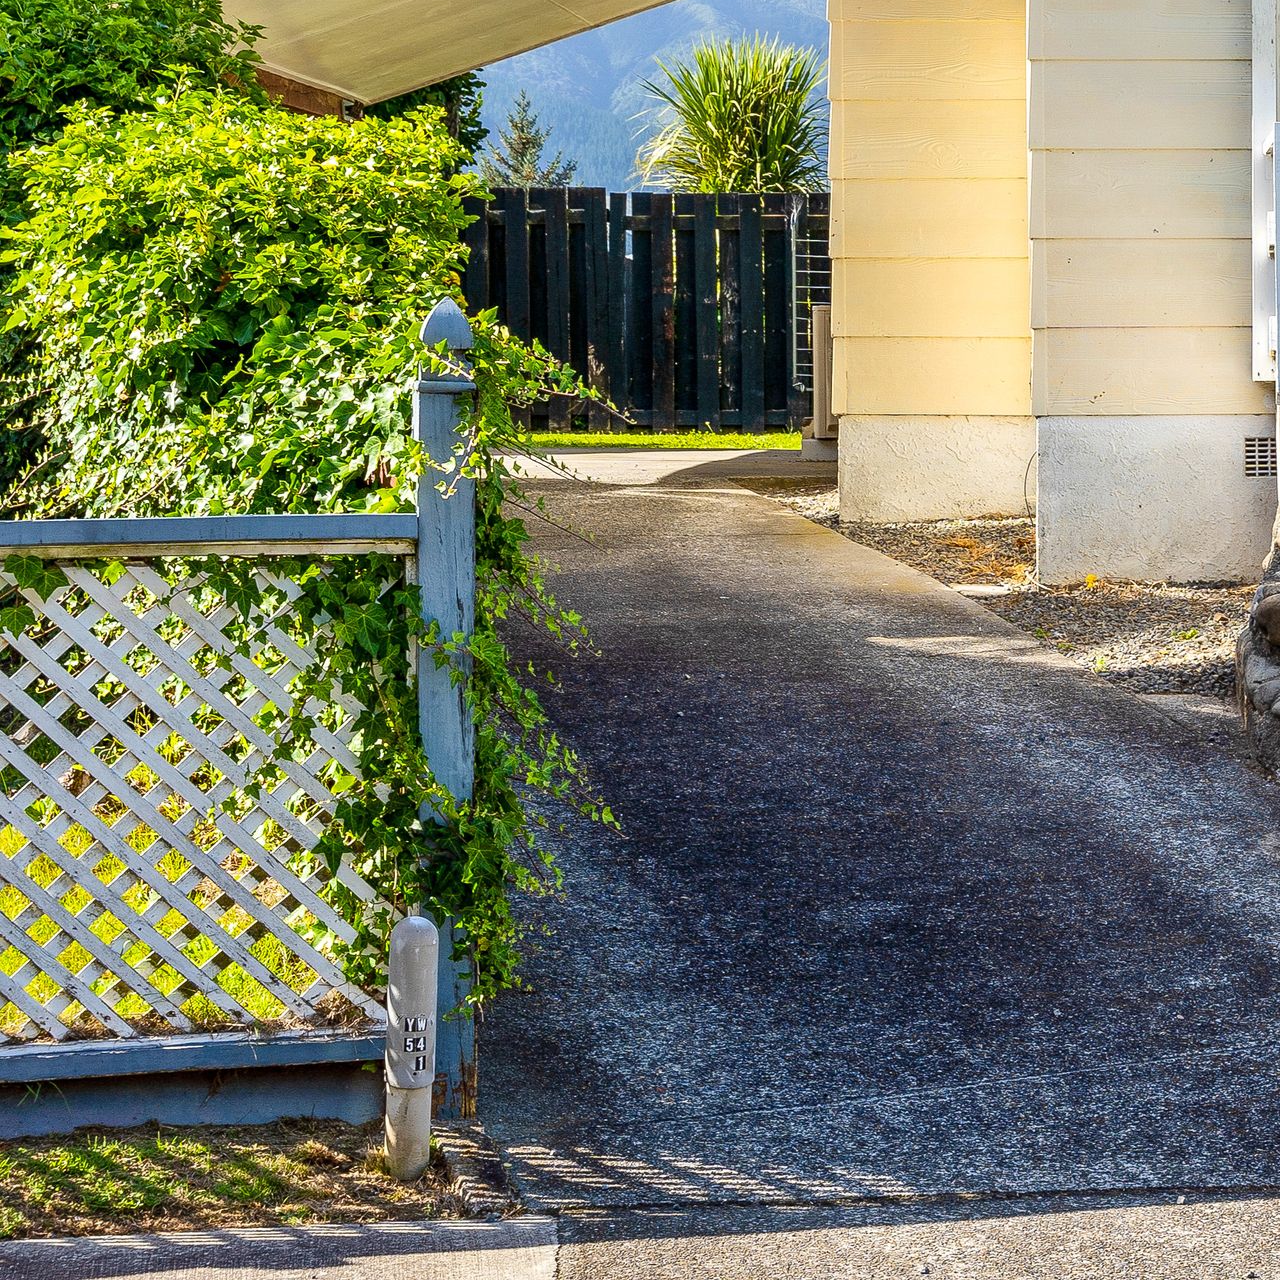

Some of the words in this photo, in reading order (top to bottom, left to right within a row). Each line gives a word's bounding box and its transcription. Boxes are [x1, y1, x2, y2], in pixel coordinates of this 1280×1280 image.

[406, 1017, 426, 1032] YW
[405, 1037, 425, 1052] 54
[417, 1056, 425, 1070] 1
